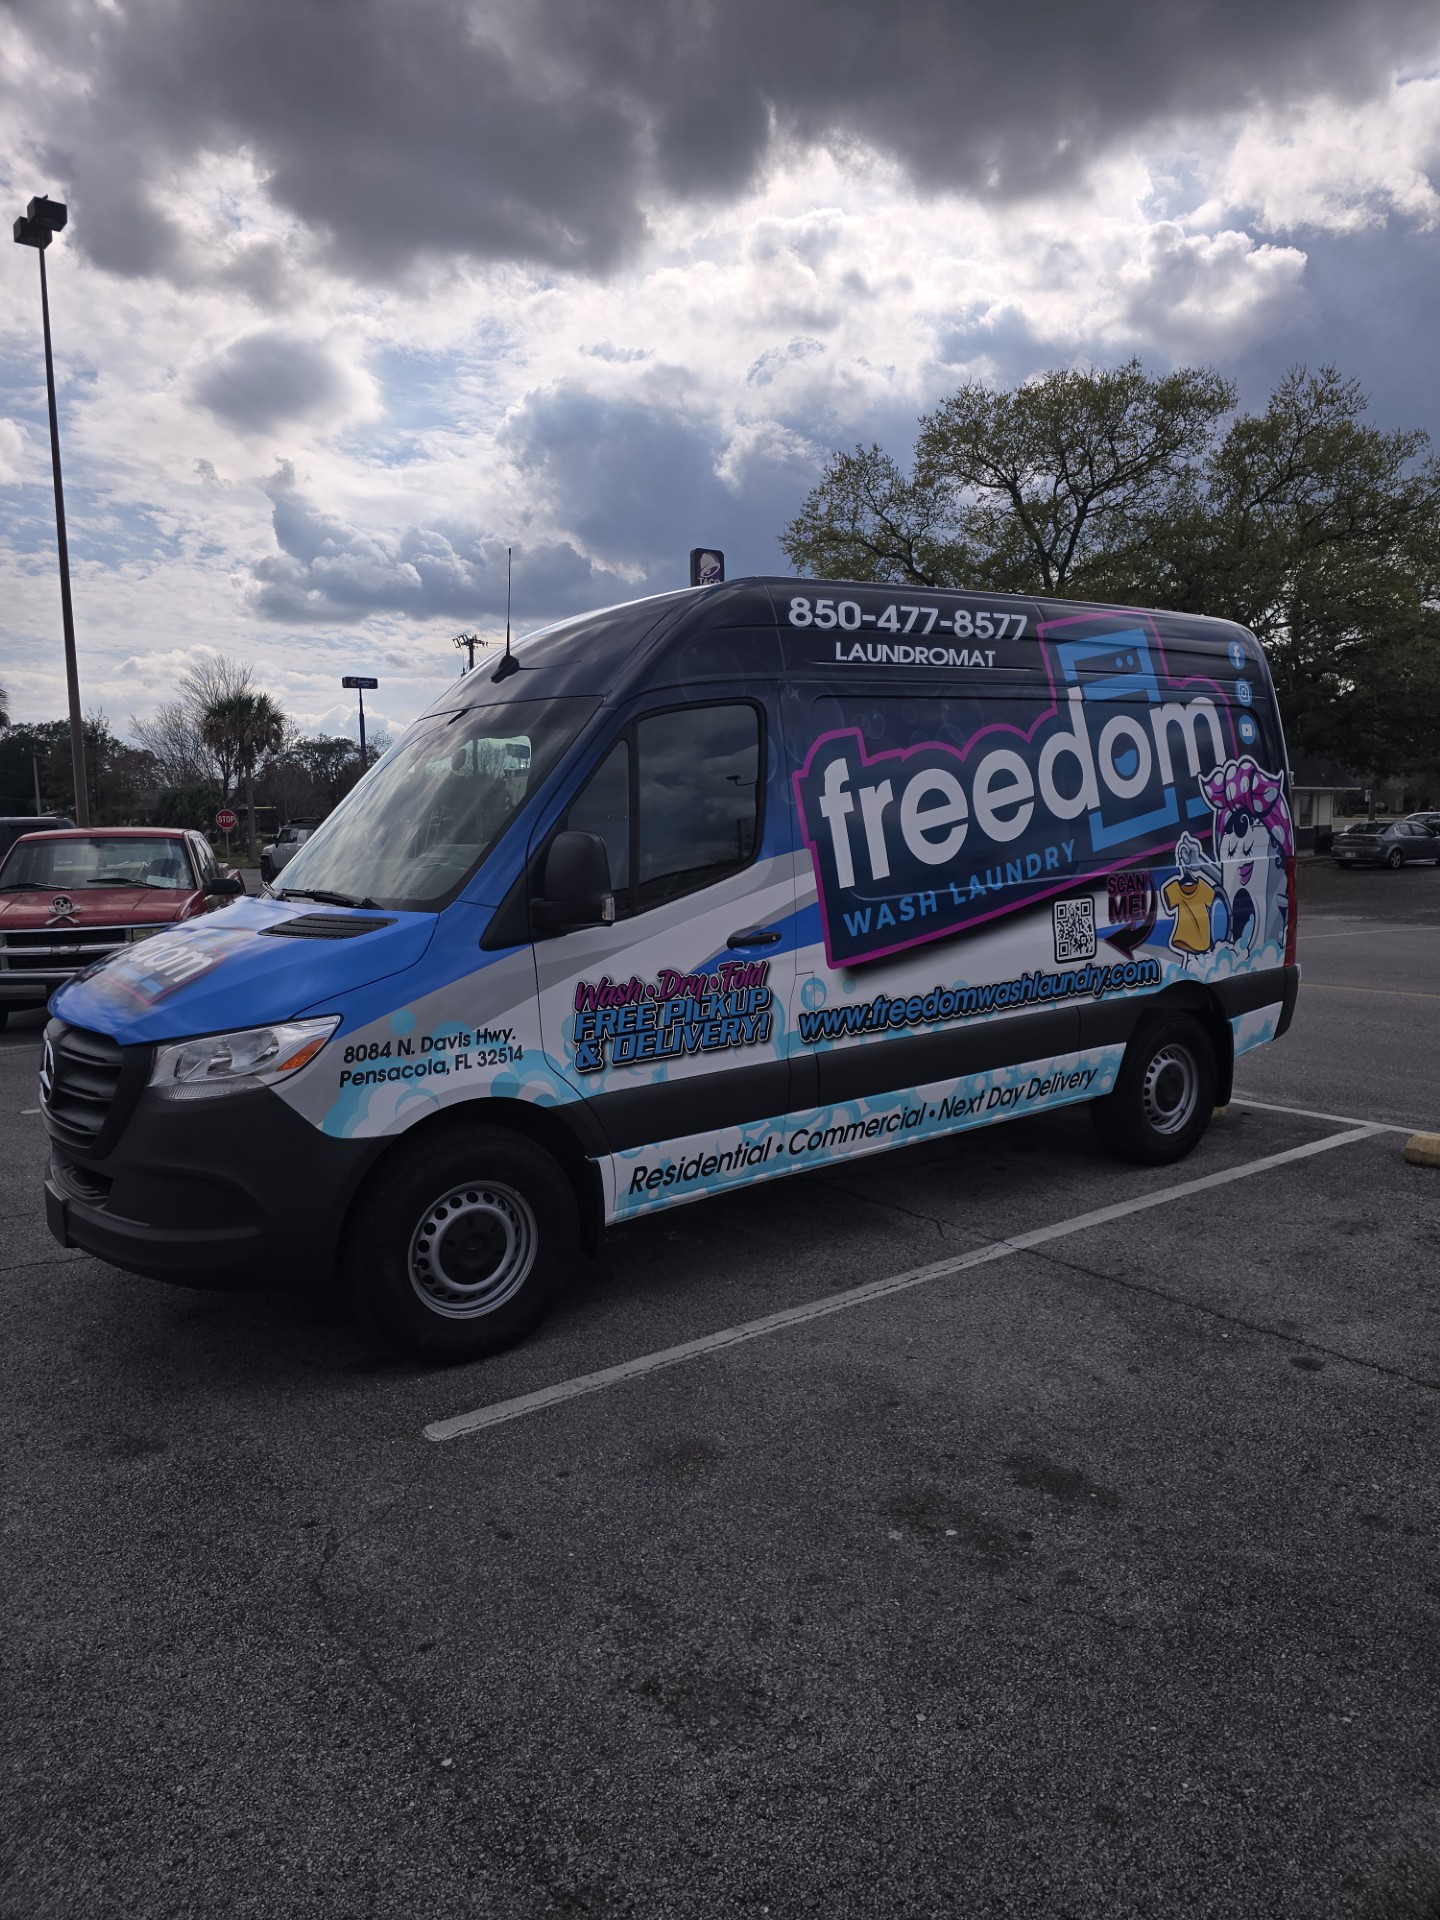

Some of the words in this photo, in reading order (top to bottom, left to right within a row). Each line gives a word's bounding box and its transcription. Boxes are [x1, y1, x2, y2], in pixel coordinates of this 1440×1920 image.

[788, 597, 1028, 641] 850-477-8577
[835, 642, 996, 668] LAUNDROMAT
[819, 686, 1226, 889] freedom
[218, 815, 236, 824] STOP
[842, 890, 938, 937] WASH
[951, 838, 1077, 905] LAUNDRY
[1107, 872, 1146, 896] SCAN
[1108, 893, 1147, 923] ME!
[574, 976, 643, 1011] Wash
[652, 968, 707, 1002] Dry
[719, 960, 767, 993] Fold
[799, 958, 1160, 1039] www.freedomwashlaundry.com
[574, 1003, 655, 1041] FREE
[664, 987, 769, 1027] PICKUP
[343, 1040, 392, 1064] 8084
[397, 1038, 416, 1057] N.
[420, 1031, 472, 1054] Davis
[476, 1027, 517, 1046] Hwy.
[575, 1039, 601, 1069] &
[612, 1012, 770, 1063] DELIVERY!
[339, 1058, 450, 1088] Pensacola,
[455, 1054, 472, 1071] FL
[477, 1044, 524, 1068] 32514
[628, 1136, 773, 1196] Residential
[789, 1102, 927, 1156] Commercial
[937, 1092, 986, 1122] Next
[986, 1084, 1025, 1110] Day
[1026, 1067, 1099, 1100] Delivery
